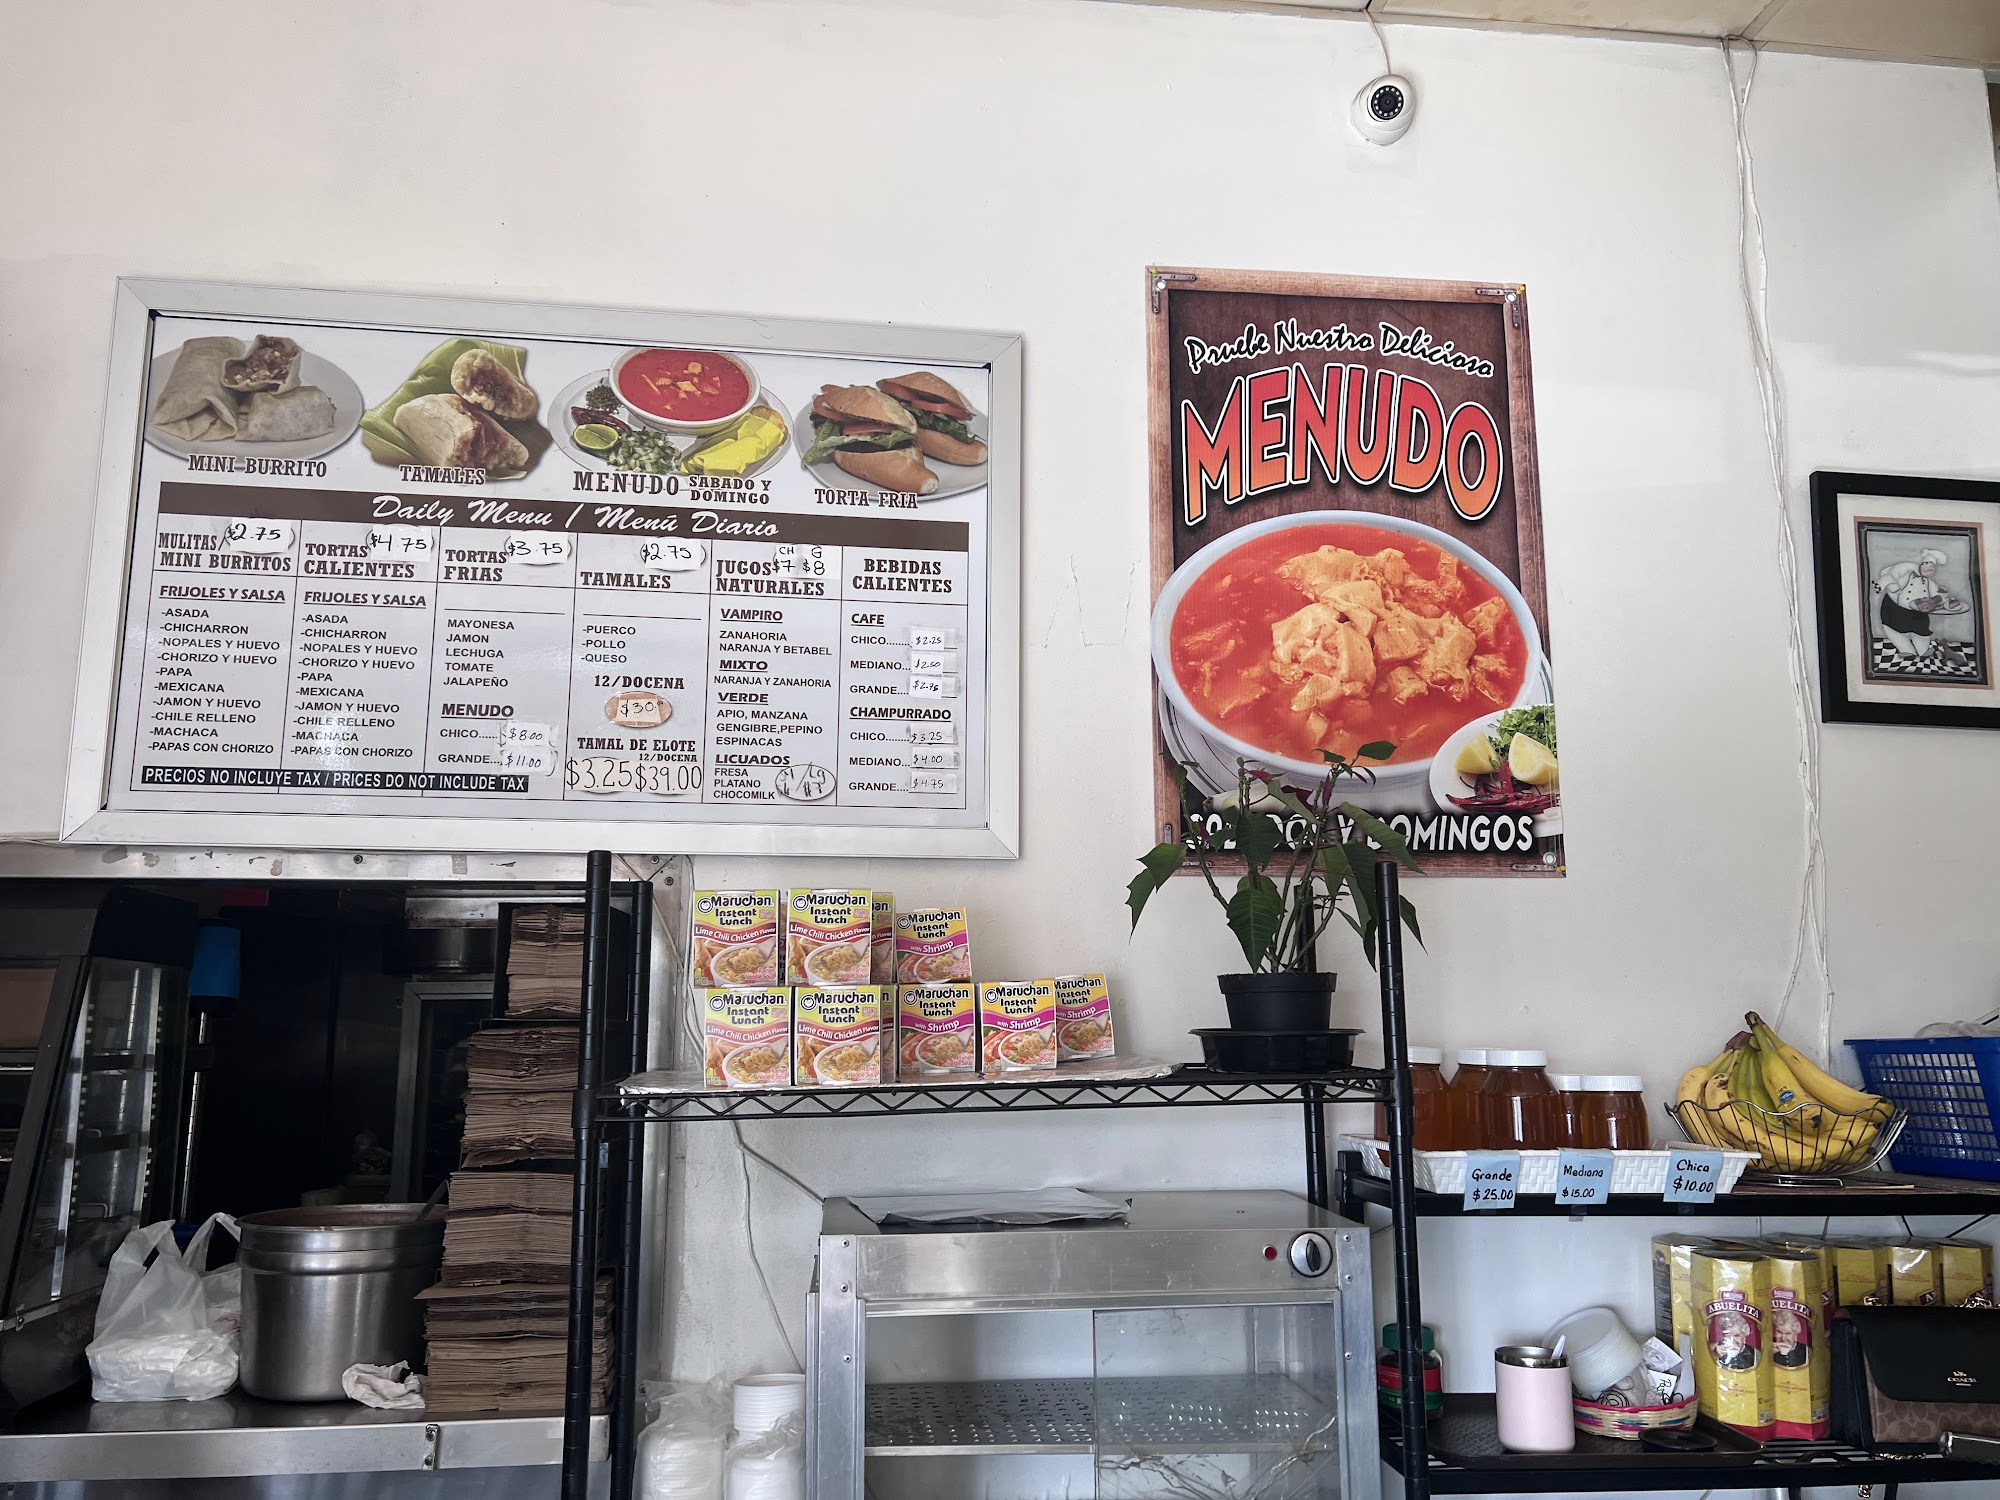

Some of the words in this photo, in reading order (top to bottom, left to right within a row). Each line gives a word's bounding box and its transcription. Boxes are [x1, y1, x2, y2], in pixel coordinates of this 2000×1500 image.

[1186, 325, 1270, 373] Pruebe
[1275, 319, 1374, 353] Nuestro
[1380, 323, 1494, 377] Delicioso
[1182, 364, 1503, 525] MENUDO
[188, 454, 236, 474] MINI
[244, 457, 327, 478] BURRITO
[400, 465, 486, 485] TAMALES
[573, 471, 679, 496] MENUDO
[689, 475, 756, 492] SABADO
[761, 479, 772, 491] Y
[690, 489, 770, 505] DOMINGO
[815, 489, 870, 507] TORTA
[878, 491, 918, 509] FRIA
[372, 495, 455, 523] Daily
[467, 498, 553, 525] Menu
[594, 505, 679, 531] Menú
[690, 508, 779, 537] Diario
[305, 543, 368, 558] TORTAS
[640, 543, 692, 563] $2.75
[160, 551, 202, 568] MINI
[208, 554, 291, 572] BURRITOS
[445, 549, 507, 565] TORTAS
[304, 559, 415, 578] CALIENTES
[716, 560, 772, 577] JUGOS
[864, 558, 941, 575] BEBIDAS
[443, 565, 503, 582] FRIAS
[581, 572, 671, 589] TAMALES
[716, 577, 824, 596] NATURALES
[852, 575, 952, 593] CALIENTES
[160, 585, 226, 598] FRIJOLES
[229, 588, 239, 599] Y
[241, 589, 285, 601] SALSA
[304, 591, 368, 604] FRIJOLES
[371, 594, 381, 604] Y
[383, 594, 426, 606] SALSA
[721, 608, 783, 621] VAMPIRO
[851, 613, 885, 624] CAFE
[447, 619, 515, 630] MAYONESA
[446, 633, 489, 643] JAMON
[719, 630, 787, 641] ZANAHORIA
[225, 640, 233, 648] Y
[236, 640, 280, 650] HUEVO
[719, 643, 771, 653] NARANJA
[774, 645, 781, 653] Y
[783, 645, 832, 655] BETABEL
[446, 648, 504, 658] LECHUGA
[222, 654, 230, 663] Y
[233, 655, 277, 665] HUEVO
[719, 660, 768, 670] MIXTO
[445, 662, 494, 672] TOMATE
[443, 676, 508, 687] JALAPEÑO
[594, 675, 685, 690] 12/DOCENA
[714, 675, 762, 685] NARANJA
[764, 677, 771, 685] Y
[773, 677, 832, 688] ZANAHORIA
[205, 698, 214, 707] Y
[217, 699, 261, 709] HUEVO
[718, 692, 769, 703] VERDE
[442, 703, 514, 717] MENUDO
[716, 709, 747, 720] APIO,
[751, 710, 808, 720] MANZANA
[850, 706, 951, 720] CHAMPURRADO
[196, 713, 256, 723] RELLENO
[577, 737, 624, 750] TAMAL
[629, 739, 647, 751] DE
[652, 739, 696, 752] ELOTE
[716, 736, 782, 747] ESPINACAS
[193, 743, 218, 752] CON
[222, 743, 274, 754] CHORIZO
[639, 753, 697, 762] 12/DOCENA
[715, 754, 790, 765] LICUADOS
[566, 757, 632, 789] $3.25
[635, 765, 702, 792] $39.00
[714, 768, 749, 777] FRESA
[145, 768, 206, 783] PRECIOS
[210, 770, 229, 784] NO
[234, 770, 292, 785] INCLUYE
[296, 772, 321, 786] TAX
[333, 772, 381, 787] PRICES
[386, 774, 404, 788] DO
[409, 774, 436, 788] NOT
[439, 775, 496, 790] INCLUDE
[501, 777, 525, 790] TAX
[714, 779, 761, 788] PLATANO
[713, 790, 776, 799] CHOCOMILK
[711, 895, 772, 907] Maruchan
[806, 894, 867, 905] Maruchan
[810, 907, 851, 916] Instant
[908, 911, 961, 923] Maruchan
[814, 915, 847, 924] Lunch
[790, 924, 808, 934] Lime
[808, 929, 824, 939] Chili
[825, 929, 853, 940] Chicken
[913, 923, 949, 931] Instant
[917, 930, 946, 939] Lunch
[923, 940, 954, 953] Shrimp
[1054, 978, 1101, 990] Maruchan
[916, 988, 969, 999] Maruchan
[996, 986, 1049, 997] Maruchan
[723, 993, 784, 1005] Maruchan
[814, 992, 875, 1004] Maruchan
[1000, 998, 1037, 1006] Instant
[818, 1005, 860, 1014] Instant
[1004, 1005, 1033, 1014] Lunch
[1067, 1007, 1096, 1018] Shrimp
[823, 1014, 855, 1023] Lunch
[1009, 1017, 1041, 1029] Shrimp
[799, 1024, 817, 1034] Lime
[817, 1029, 833, 1039] Chili
[834, 1028, 862, 1040] Chicken
[927, 1020, 960, 1032] Shrimp
[1676, 1159, 1710, 1173] Chica
[1472, 1168, 1512, 1182] Grande
[1672, 1175, 1714, 1194] $10.00
[1472, 1188, 1513, 1202] $25.00
[1561, 1186, 1595, 1198] $15.00
[1709, 1301, 1759, 1317] ABUELITA
[1772, 1301, 1810, 1316] UELITA
